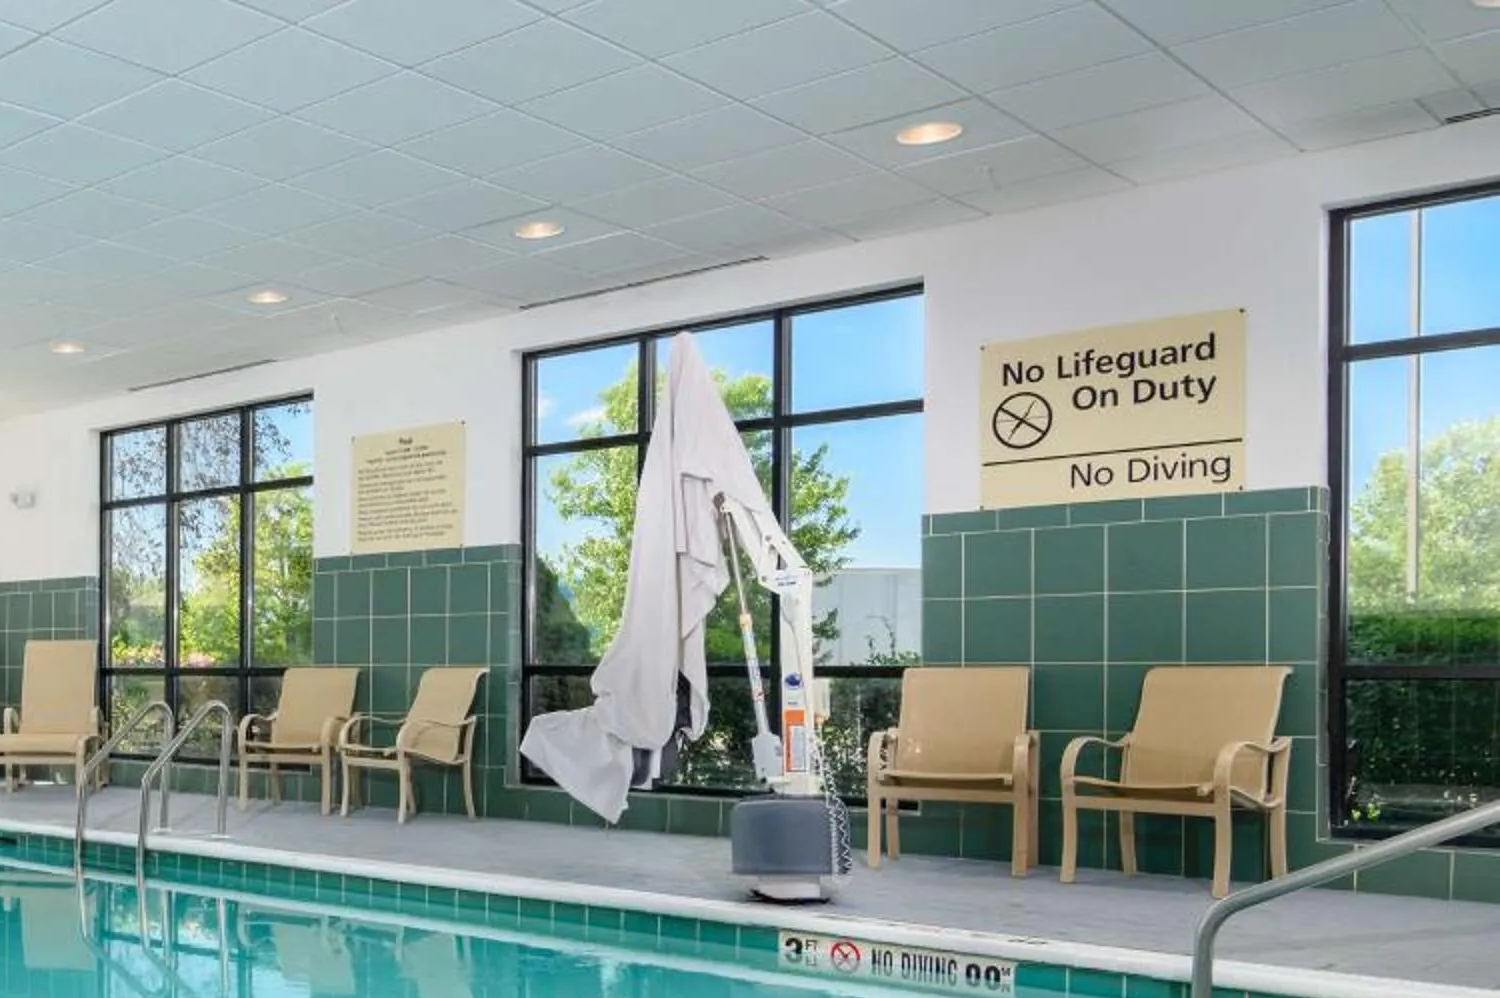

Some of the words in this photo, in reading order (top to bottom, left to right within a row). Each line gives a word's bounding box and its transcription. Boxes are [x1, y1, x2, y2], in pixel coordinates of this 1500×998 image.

[1002, 361, 1044, 386] No
[1057, 332, 1215, 379] Lifeguard
[1072, 386, 1118, 410] On
[1133, 376, 1217, 404] Duty
[1070, 463, 1113, 489] No
[1127, 453, 1231, 483] Diving
